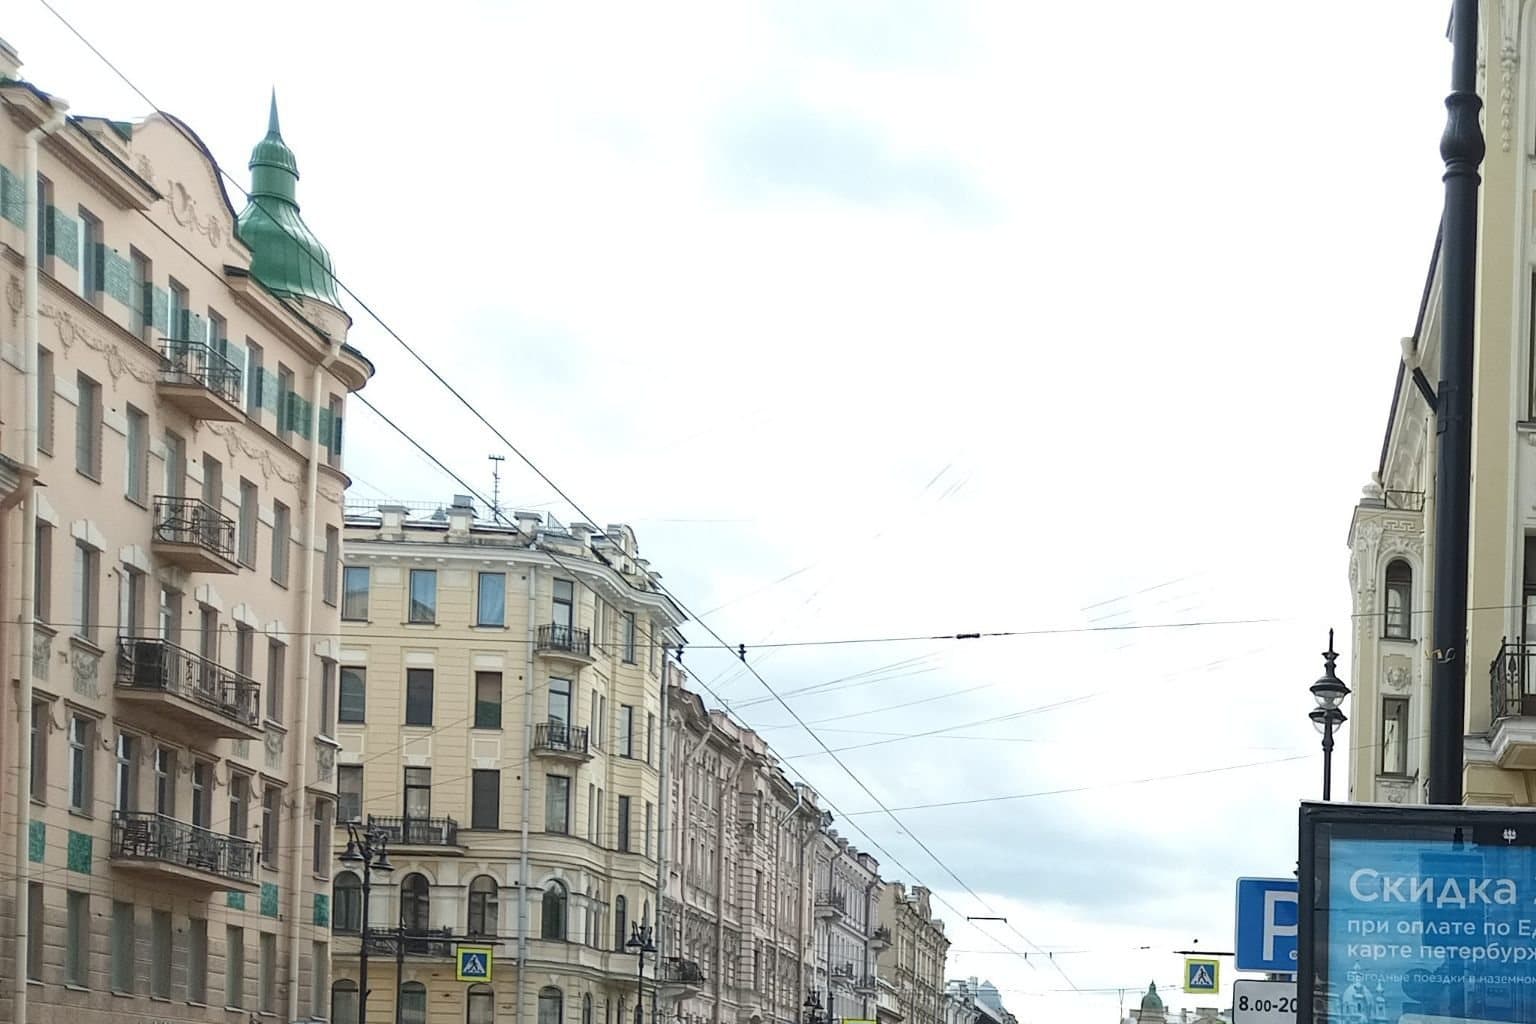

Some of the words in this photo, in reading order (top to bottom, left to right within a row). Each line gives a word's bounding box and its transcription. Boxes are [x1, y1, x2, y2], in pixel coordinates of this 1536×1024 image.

[1350, 868, 1517, 909] Скидка
[1347, 920, 1389, 936] при
[1396, 921, 1476, 936] оплате
[1484, 922, 1510, 936] по
[1347, 943, 1412, 961] карте
[1413, 973, 1465, 985] поездки
